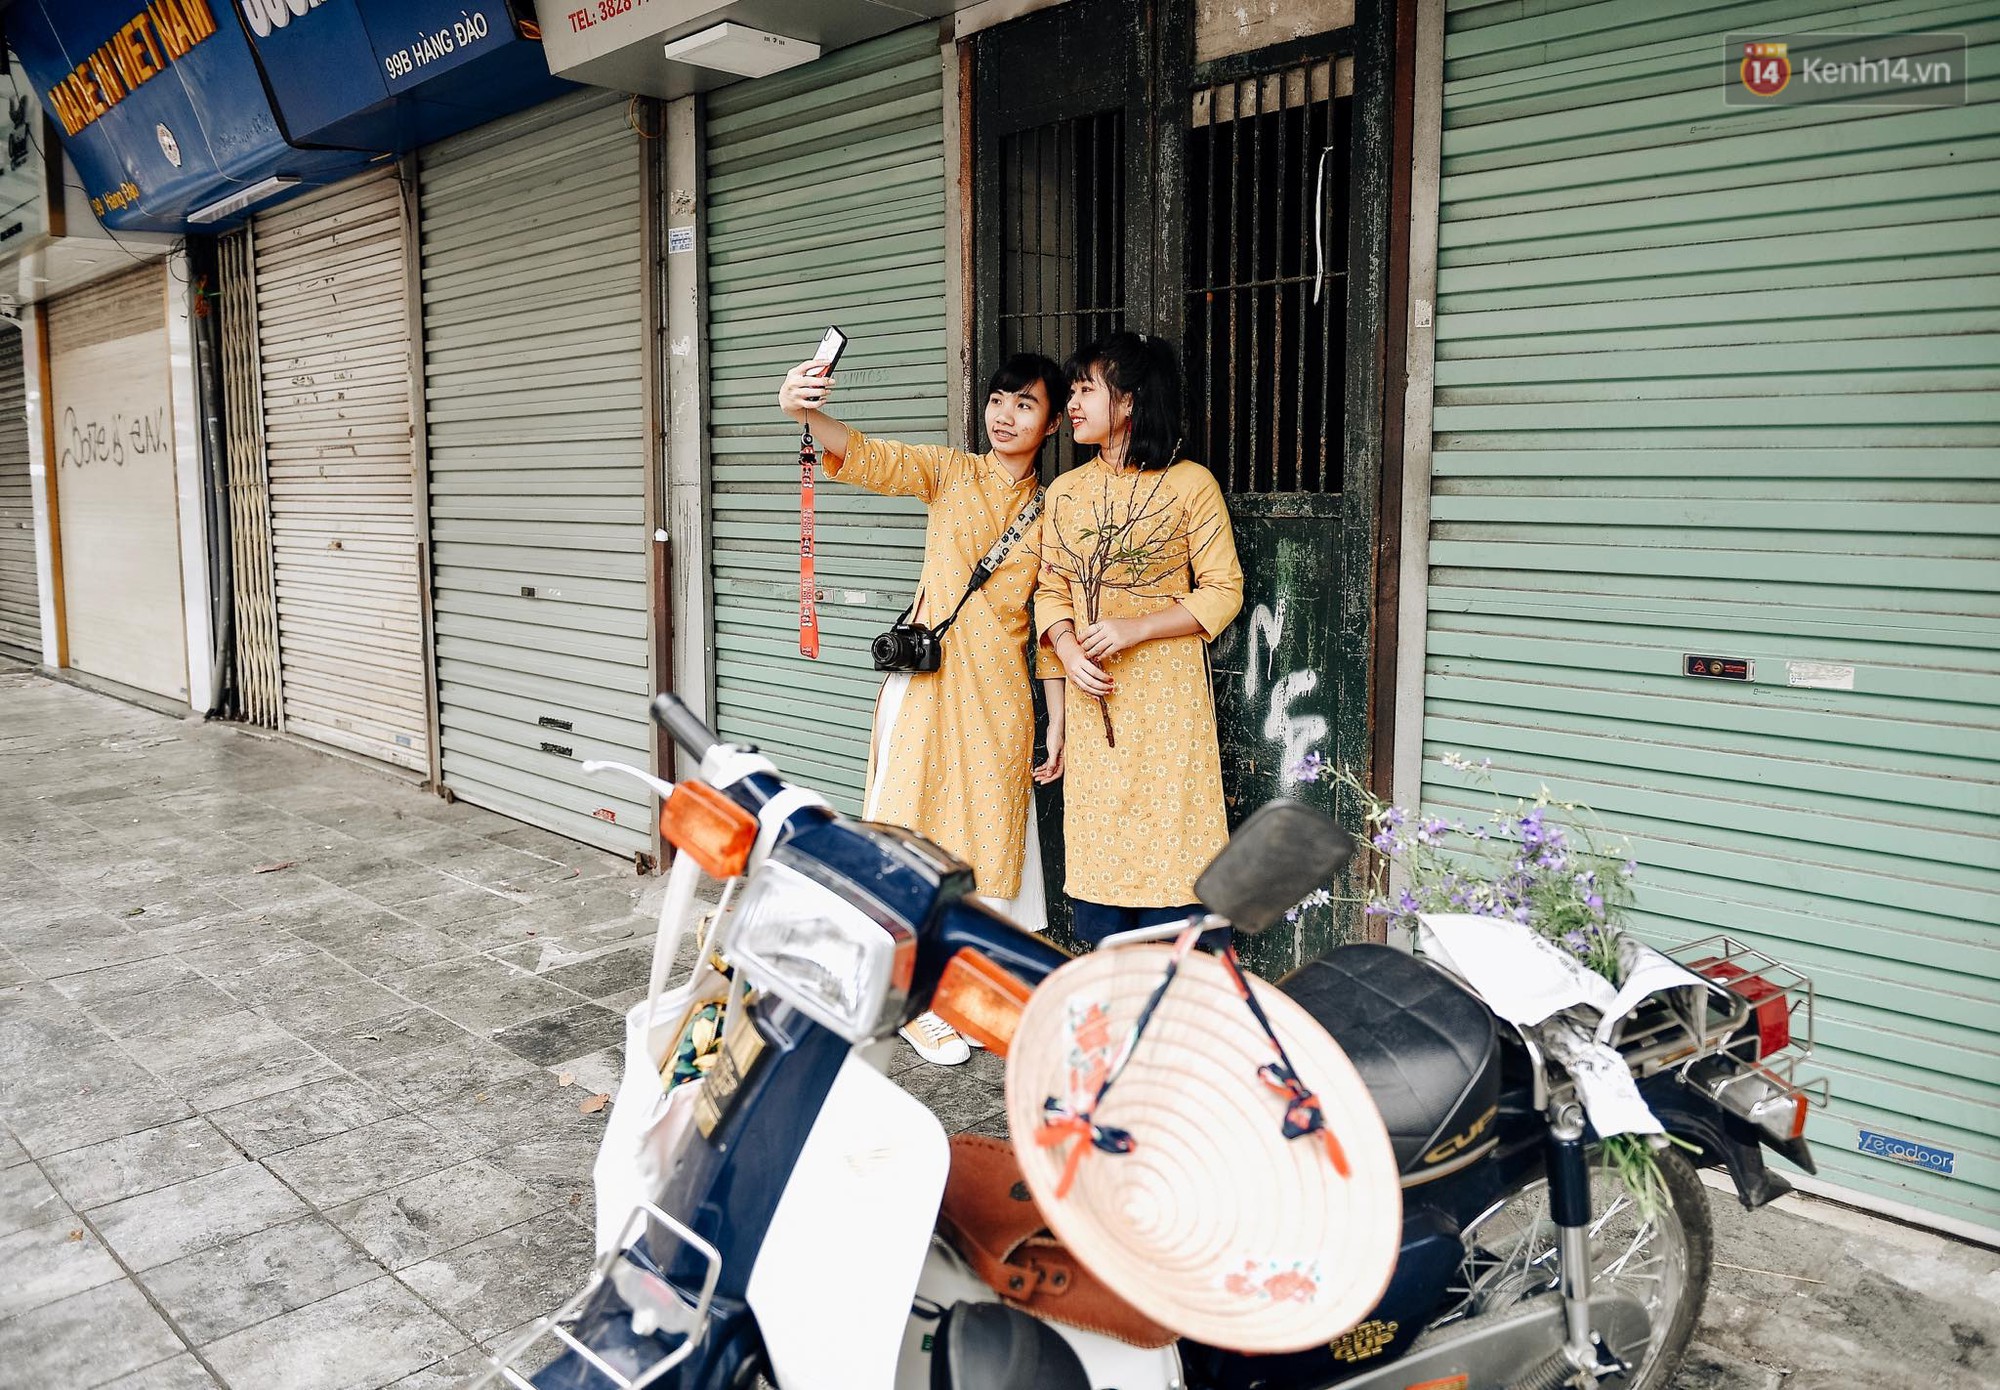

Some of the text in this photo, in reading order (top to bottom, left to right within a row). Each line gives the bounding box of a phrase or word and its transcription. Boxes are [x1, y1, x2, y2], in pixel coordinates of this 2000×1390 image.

[147, 0, 217, 61] NAM
[385, 10, 488, 79] 99B HÀNG ĐÀO
[568, 8, 597, 33] TEL:
[88, 46, 126, 106] IN
[104, 12, 166, 91] VIET
[48, 63, 111, 136] MADE
[1424, 1104, 1498, 1164] CUP
